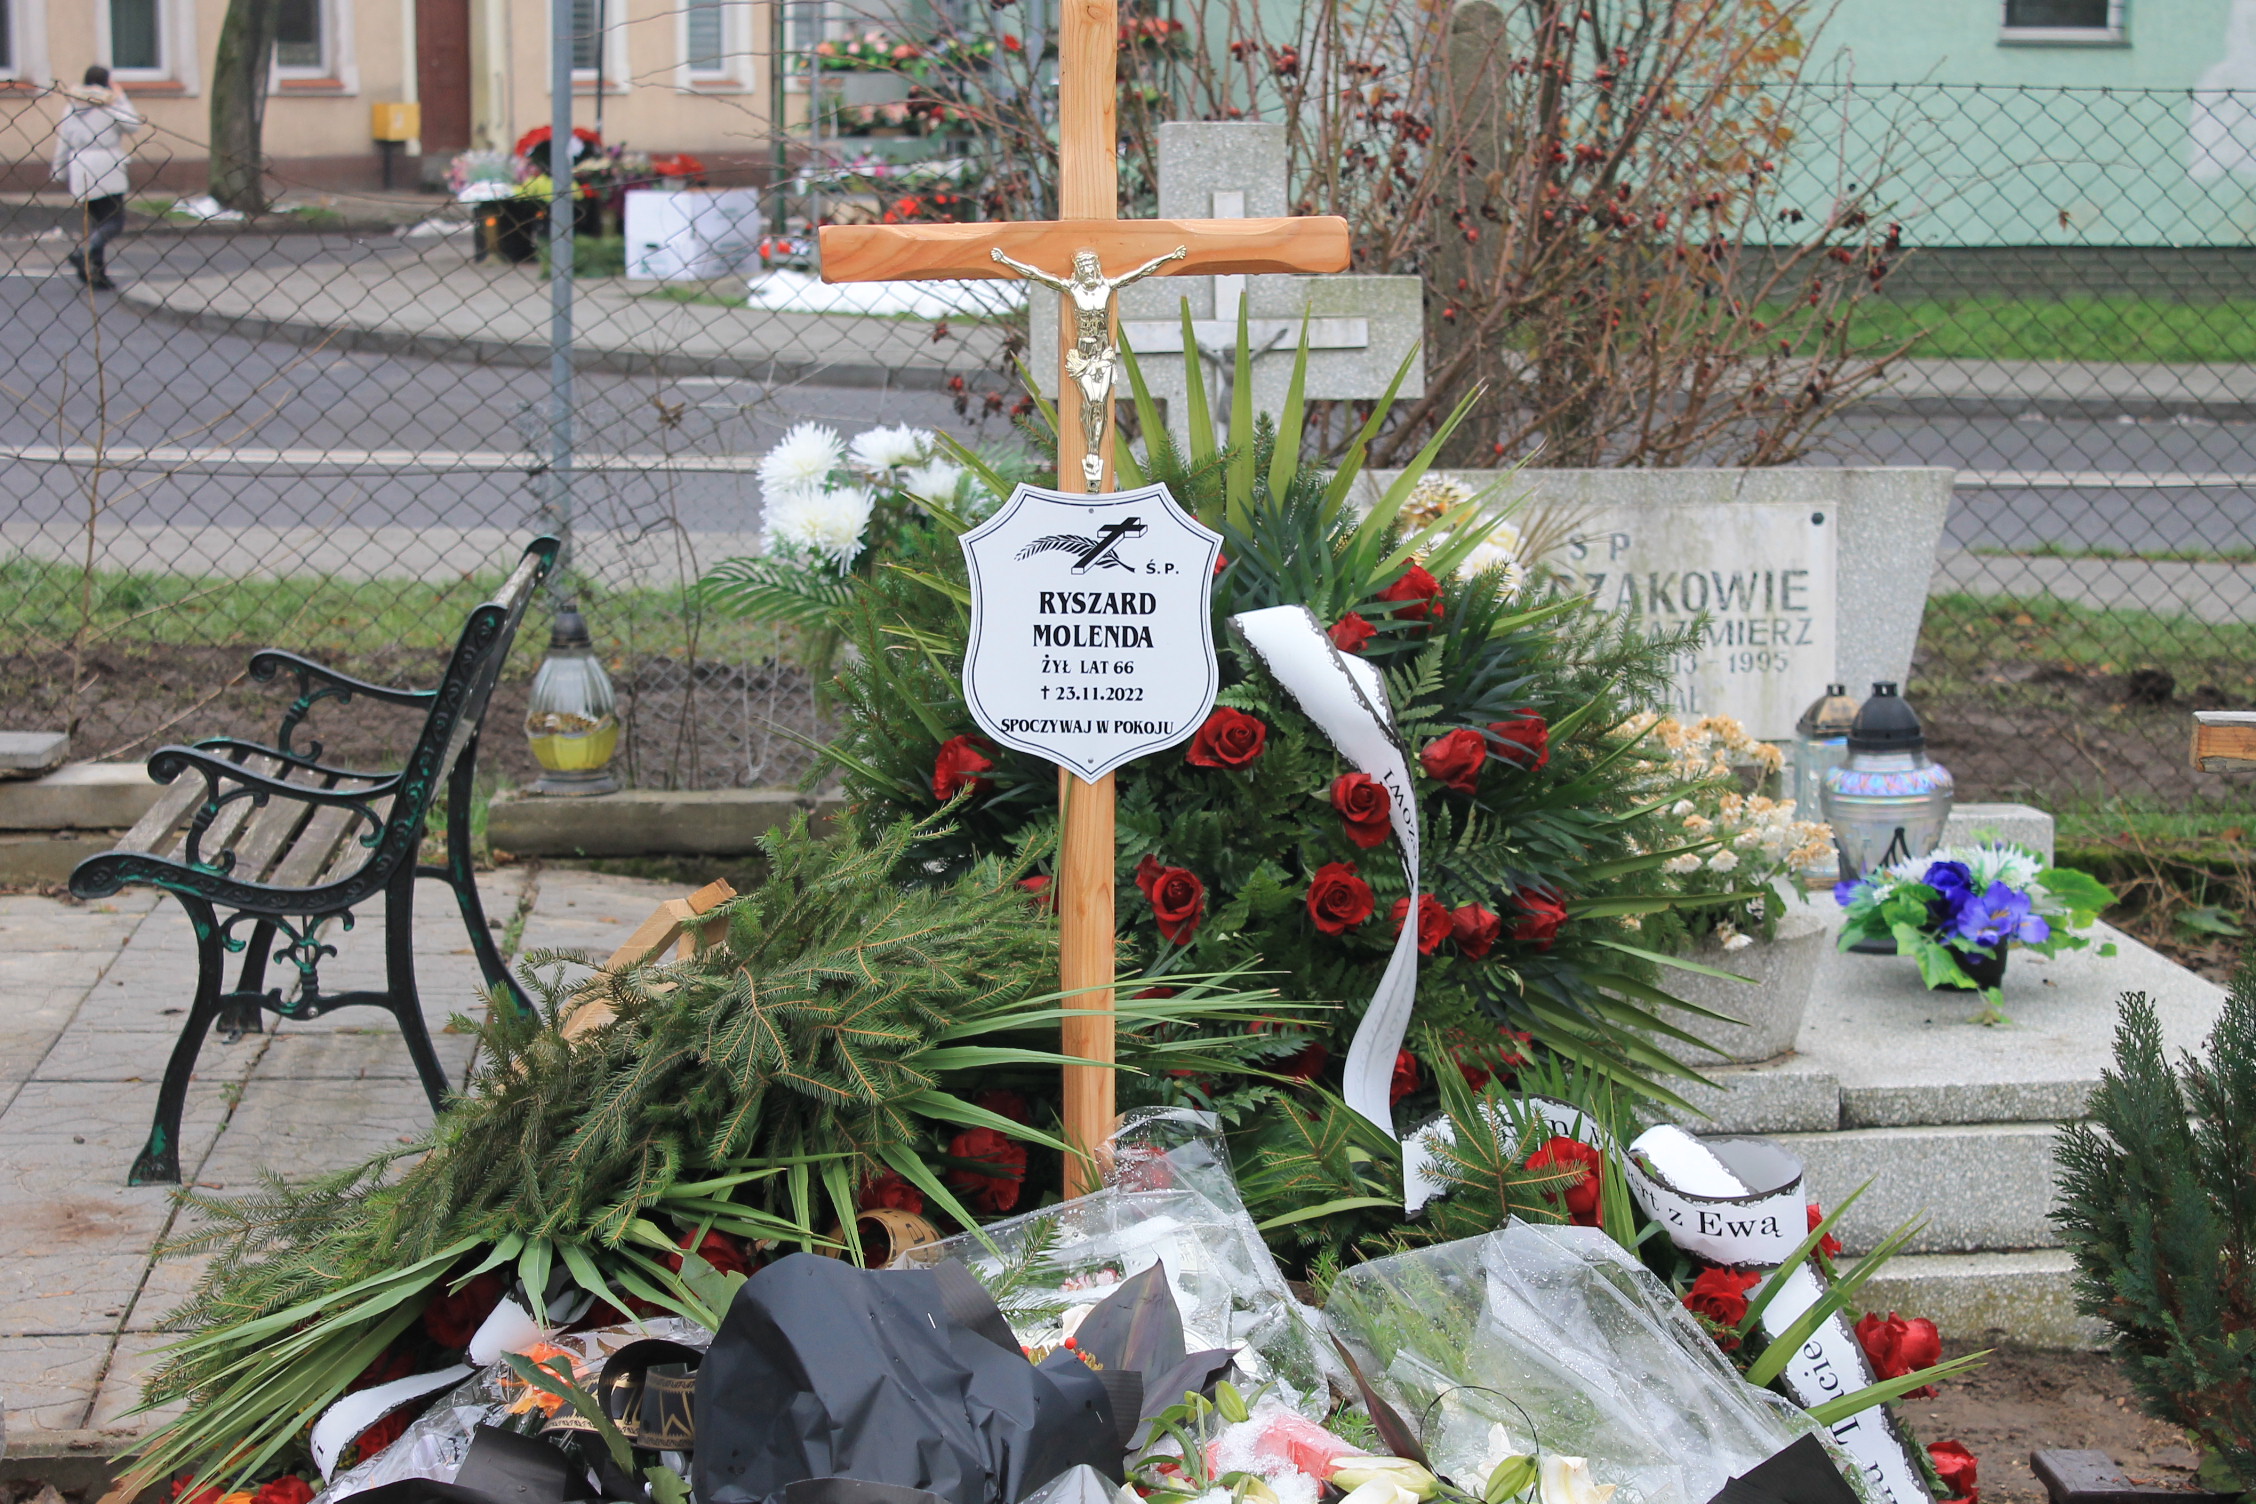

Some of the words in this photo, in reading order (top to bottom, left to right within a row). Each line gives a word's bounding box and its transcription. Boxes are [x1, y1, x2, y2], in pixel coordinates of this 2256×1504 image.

[1040, 592, 1156, 614] RYSZARD
[1034, 625, 1153, 648] MOLENDA
[1042, 654, 1070, 673] ŻYŁ
[1081, 661, 1108, 674] LAT
[1114, 661, 1133, 674] 66
[1729, 652, 1790, 675] 1995
[1056, 687, 1143, 701] 23.11.2022
[1001, 718, 1092, 734] SPOCZYWAJ
[1097, 721, 1109, 733] W
[1114, 720, 1174, 735] POKOJU
[1668, 1207, 1684, 1227] z
[1696, 1210, 1784, 1239] Ewą
[1803, 1339, 1862, 1446] Tcie
